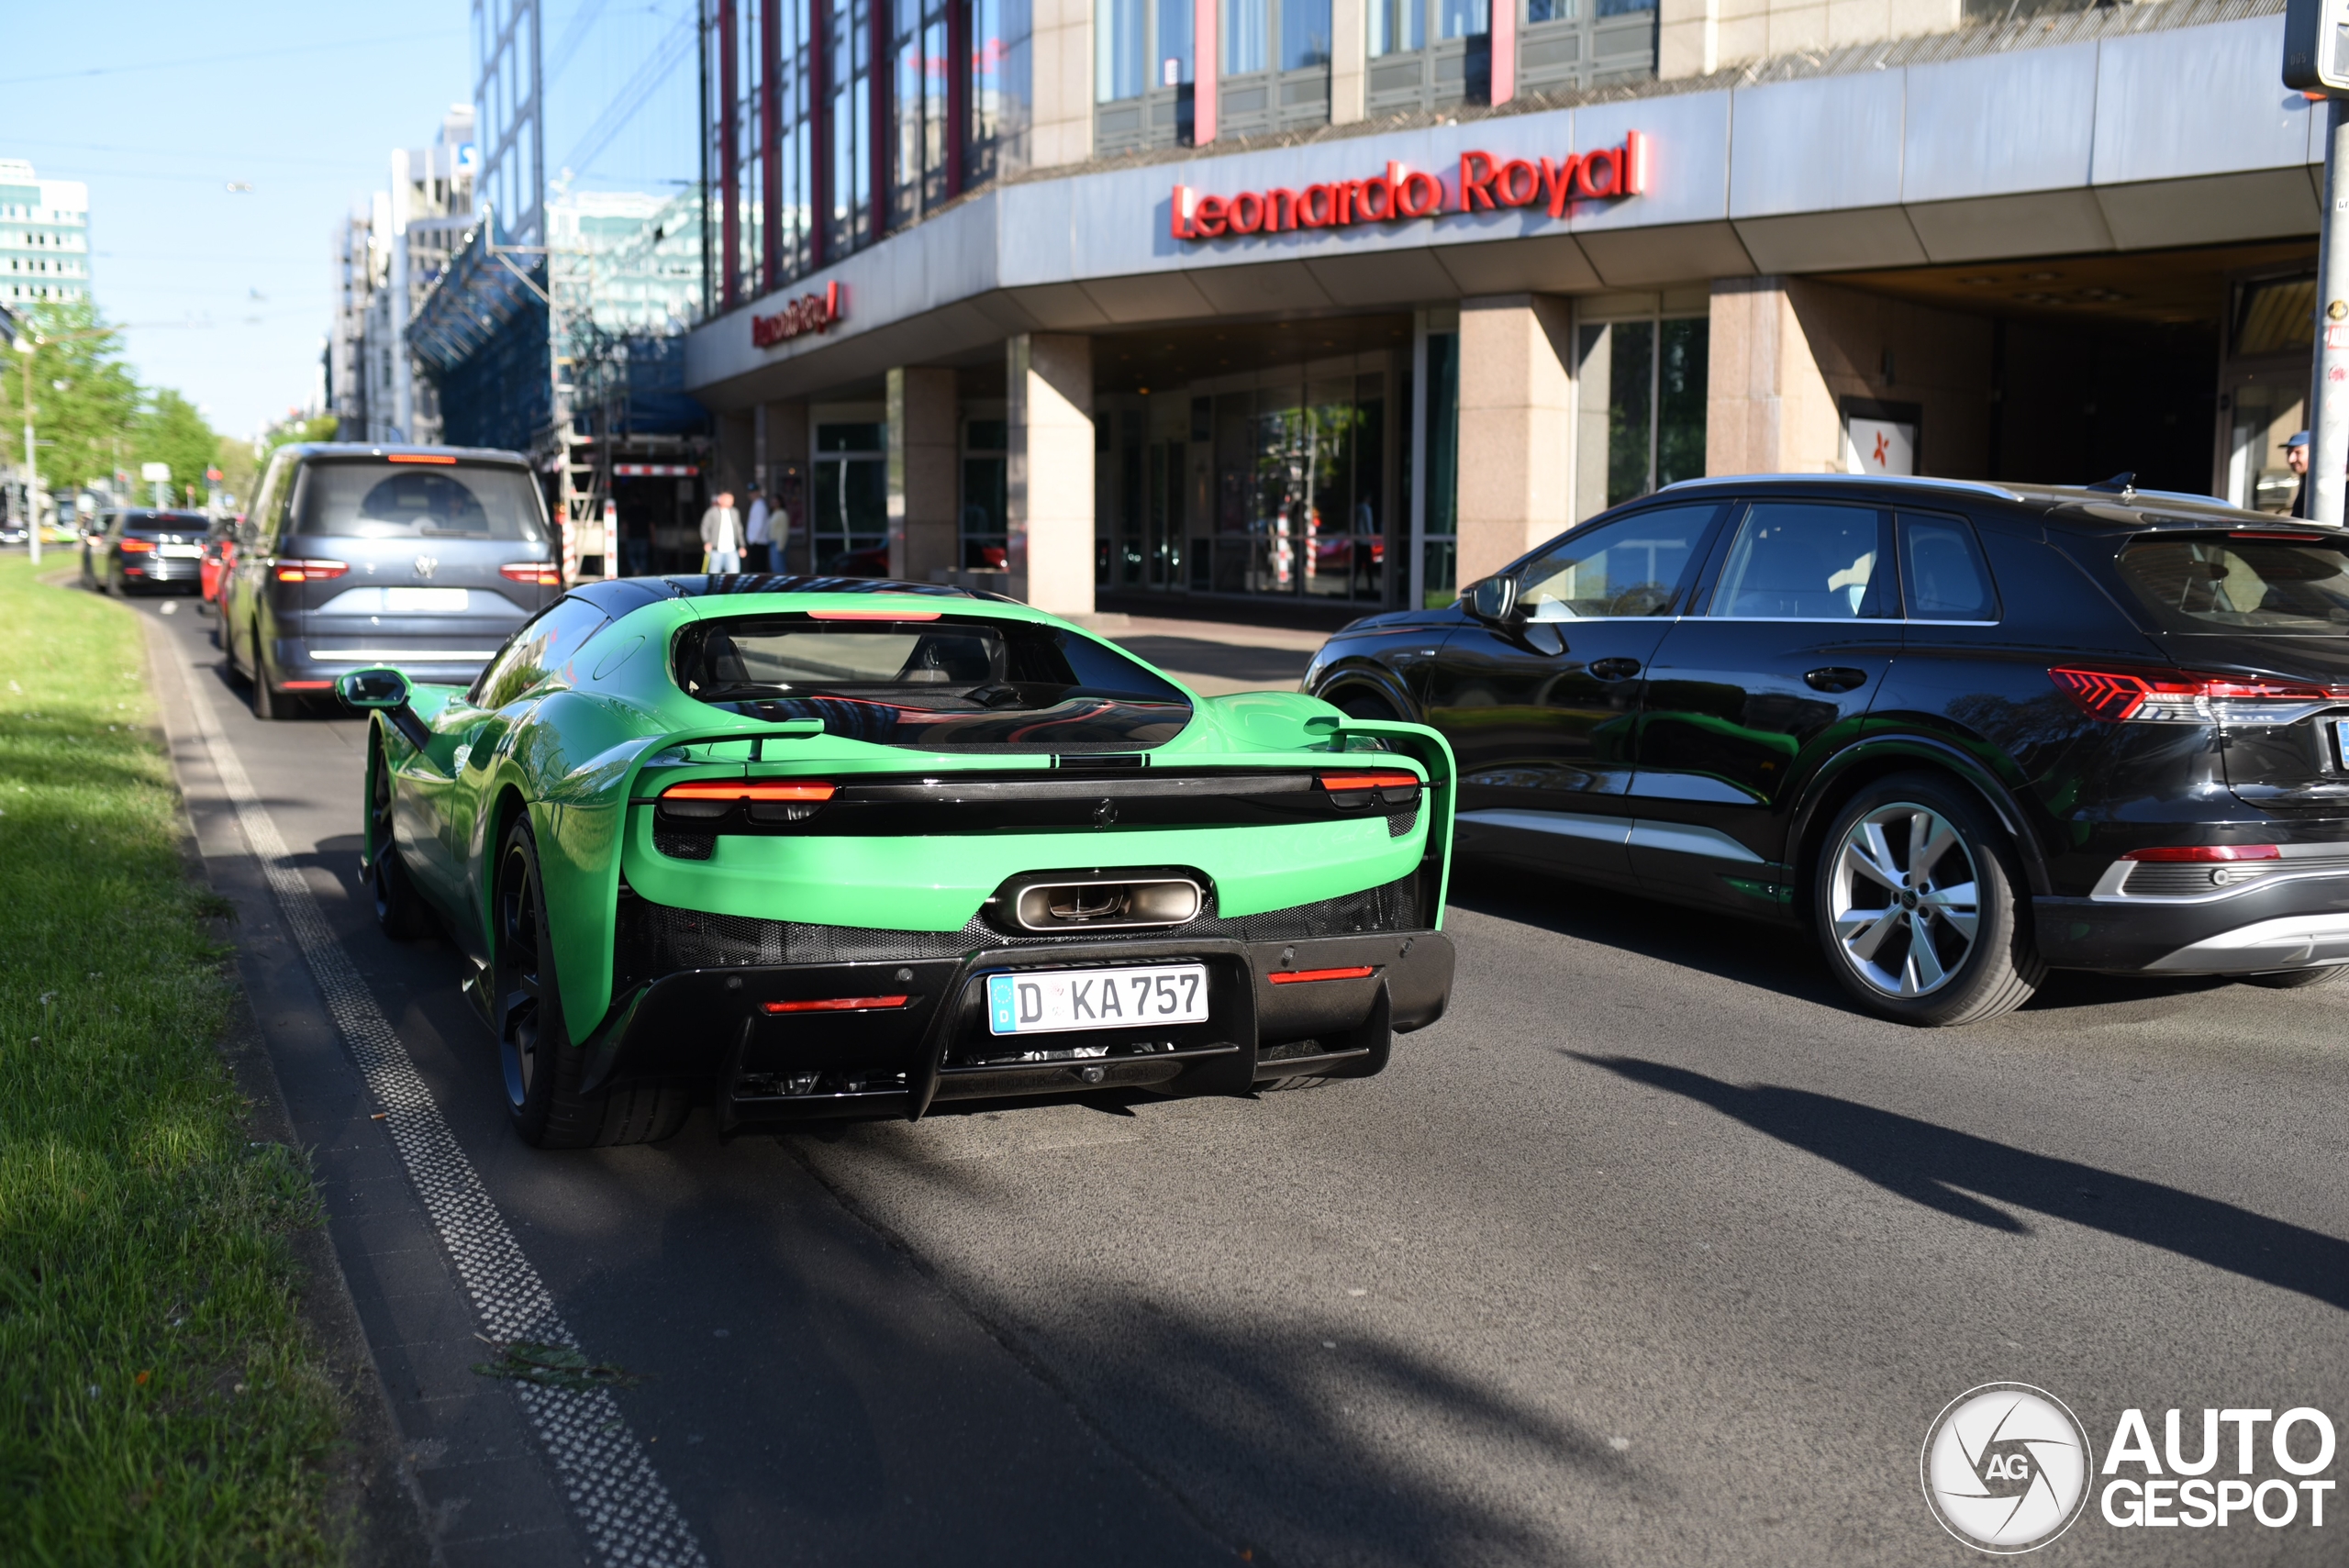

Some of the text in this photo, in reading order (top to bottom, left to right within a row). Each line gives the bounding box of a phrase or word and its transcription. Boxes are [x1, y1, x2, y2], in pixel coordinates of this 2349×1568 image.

[1172, 129, 1646, 239] Leonardo Royal
[999, 1010, 1009, 1023] D
[1018, 973, 1199, 1023] D KA 757
